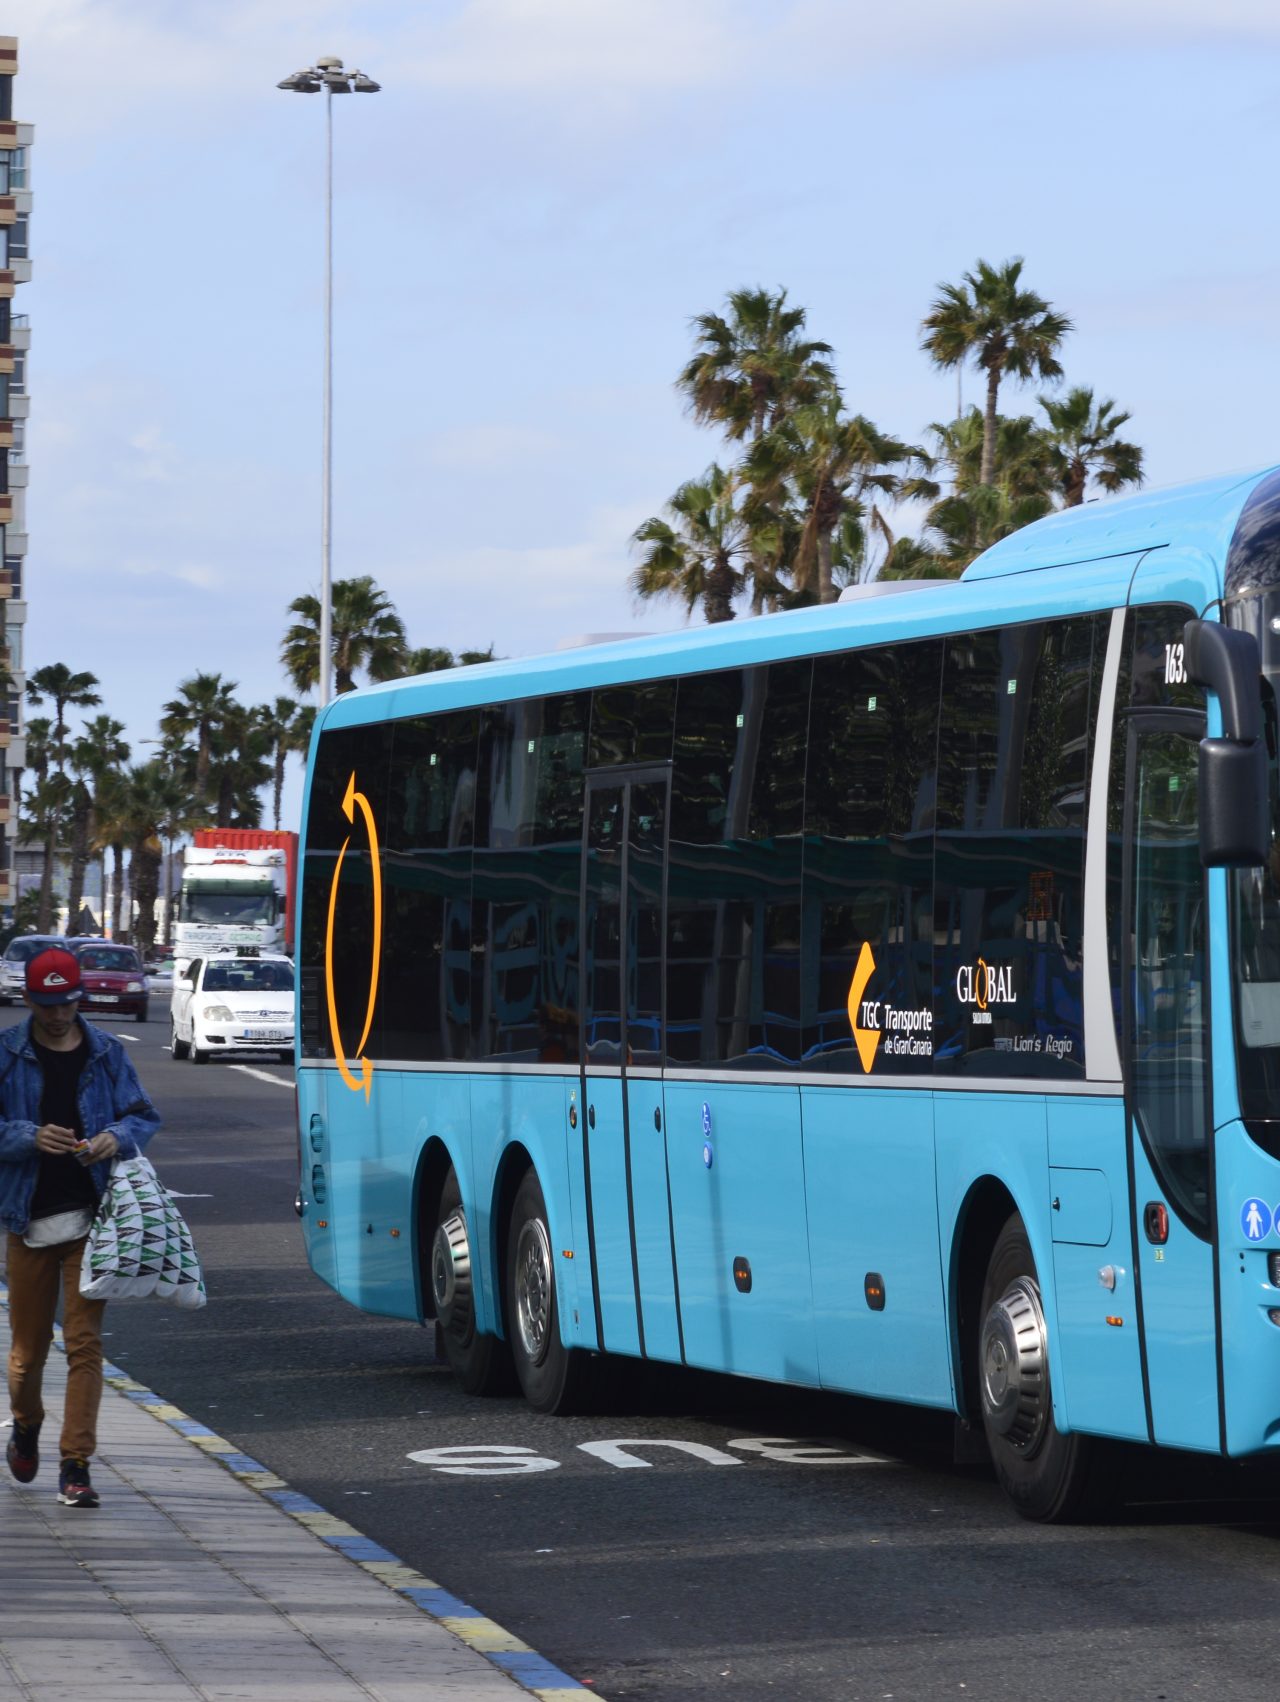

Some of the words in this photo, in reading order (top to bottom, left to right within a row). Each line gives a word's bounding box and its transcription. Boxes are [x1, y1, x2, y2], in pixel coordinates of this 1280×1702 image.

[1165, 643, 1188, 685] 163
[956, 957, 1017, 1011] GLOBAL
[861, 1001, 881, 1029] TGC
[884, 1004, 933, 1037] Transporte
[884, 1036, 893, 1054] de
[1014, 1033, 1042, 1052] Lion's
